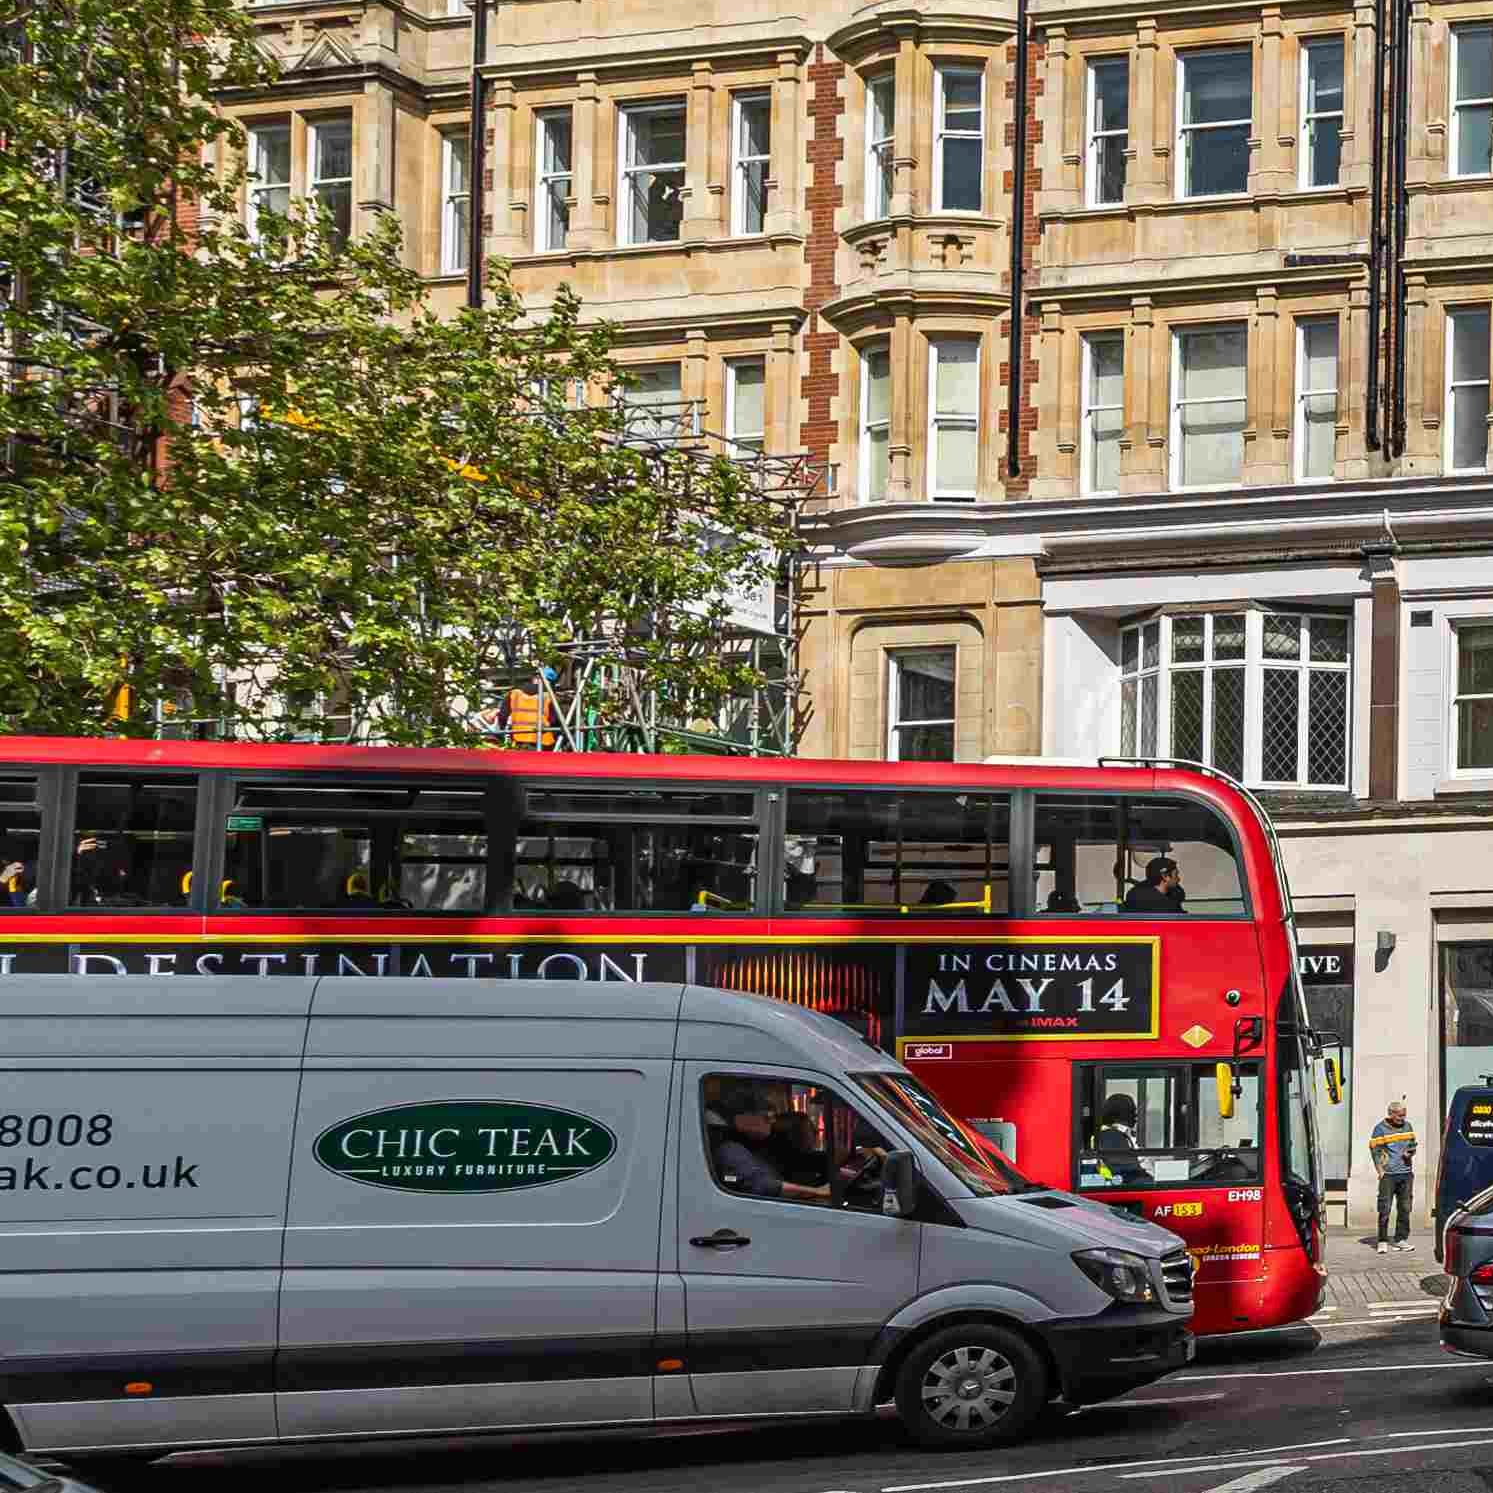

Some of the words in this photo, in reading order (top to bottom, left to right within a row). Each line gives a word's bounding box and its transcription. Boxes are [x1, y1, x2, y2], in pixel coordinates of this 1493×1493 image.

[938, 954, 971, 971] IN
[985, 954, 1117, 971] CINEMAS
[921, 978, 1055, 1013] MAY
[1074, 977, 1131, 1012] 14
[1031, 1017, 1079, 1027] IMAX
[0, 1114, 113, 1148] 8008
[341, 1128, 461, 1159] CHIC
[477, 1127, 593, 1157] TEAK
[382, 1164, 447, 1177] LUXURY
[455, 1163, 547, 1176] FURNITURE
[1154, 1205, 1172, 1217] AF
